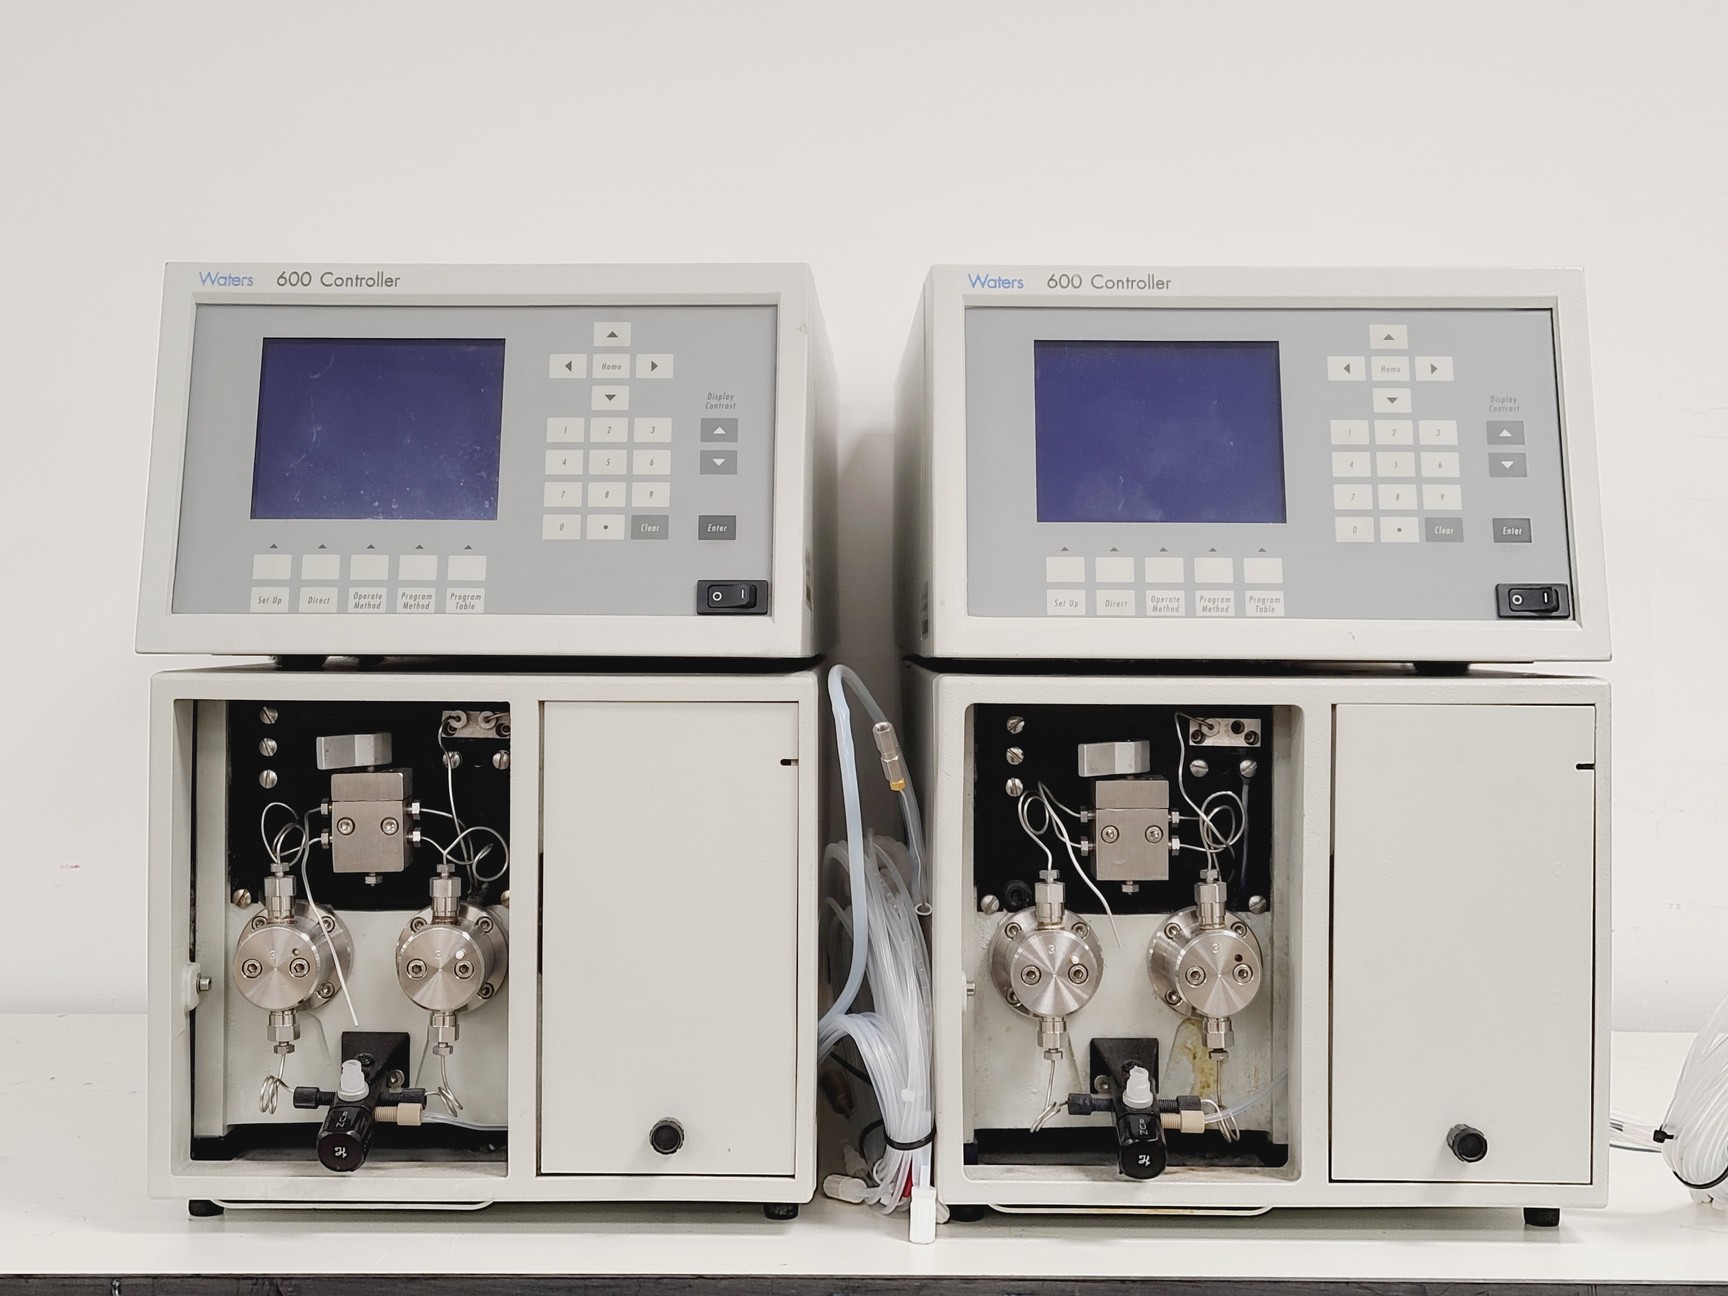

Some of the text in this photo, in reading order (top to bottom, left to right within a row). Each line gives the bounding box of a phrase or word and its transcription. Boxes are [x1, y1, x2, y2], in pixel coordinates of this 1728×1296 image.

[199, 271, 254, 287] Waters
[276, 271, 401, 288] 600 Controller
[968, 273, 1025, 289] Waters
[1046, 274, 1172, 290] 600 Controller
[601, 362, 622, 370] Home
[1380, 365, 1401, 373] Home
[707, 393, 735, 402] Display
[1490, 395, 1517, 404] Display
[705, 401, 736, 410] Contrast
[1488, 405, 1520, 413] Contrast
[563, 426, 567, 434] 1
[607, 426, 612, 434] 2
[650, 426, 655, 434] 3
[605, 491, 609, 499] 8
[649, 491, 654, 499] 9
[640, 523, 660, 532] Clear
[707, 524, 728, 532] Enter
[1434, 526, 1454, 535] Clear
[1502, 527, 1523, 535] Enter
[258, 596, 282, 605] Set Up
[307, 596, 330, 604] Direct
[353, 592, 383, 601] Operate
[401, 592, 433, 601] Program
[450, 593, 482, 602] Program
[1150, 595, 1180, 604] Operate
[1199, 596, 1231, 605] Program
[1249, 596, 1281, 605] Program
[353, 601, 382, 610] Method
[403, 602, 430, 610] Method
[455, 602, 475, 610] Table
[1054, 599, 1079, 608] Set Up
[1152, 605, 1180, 613] Method
[1201, 605, 1230, 613] Method
[1255, 605, 1275, 613] Table
[1048, 944, 1055, 955] 3
